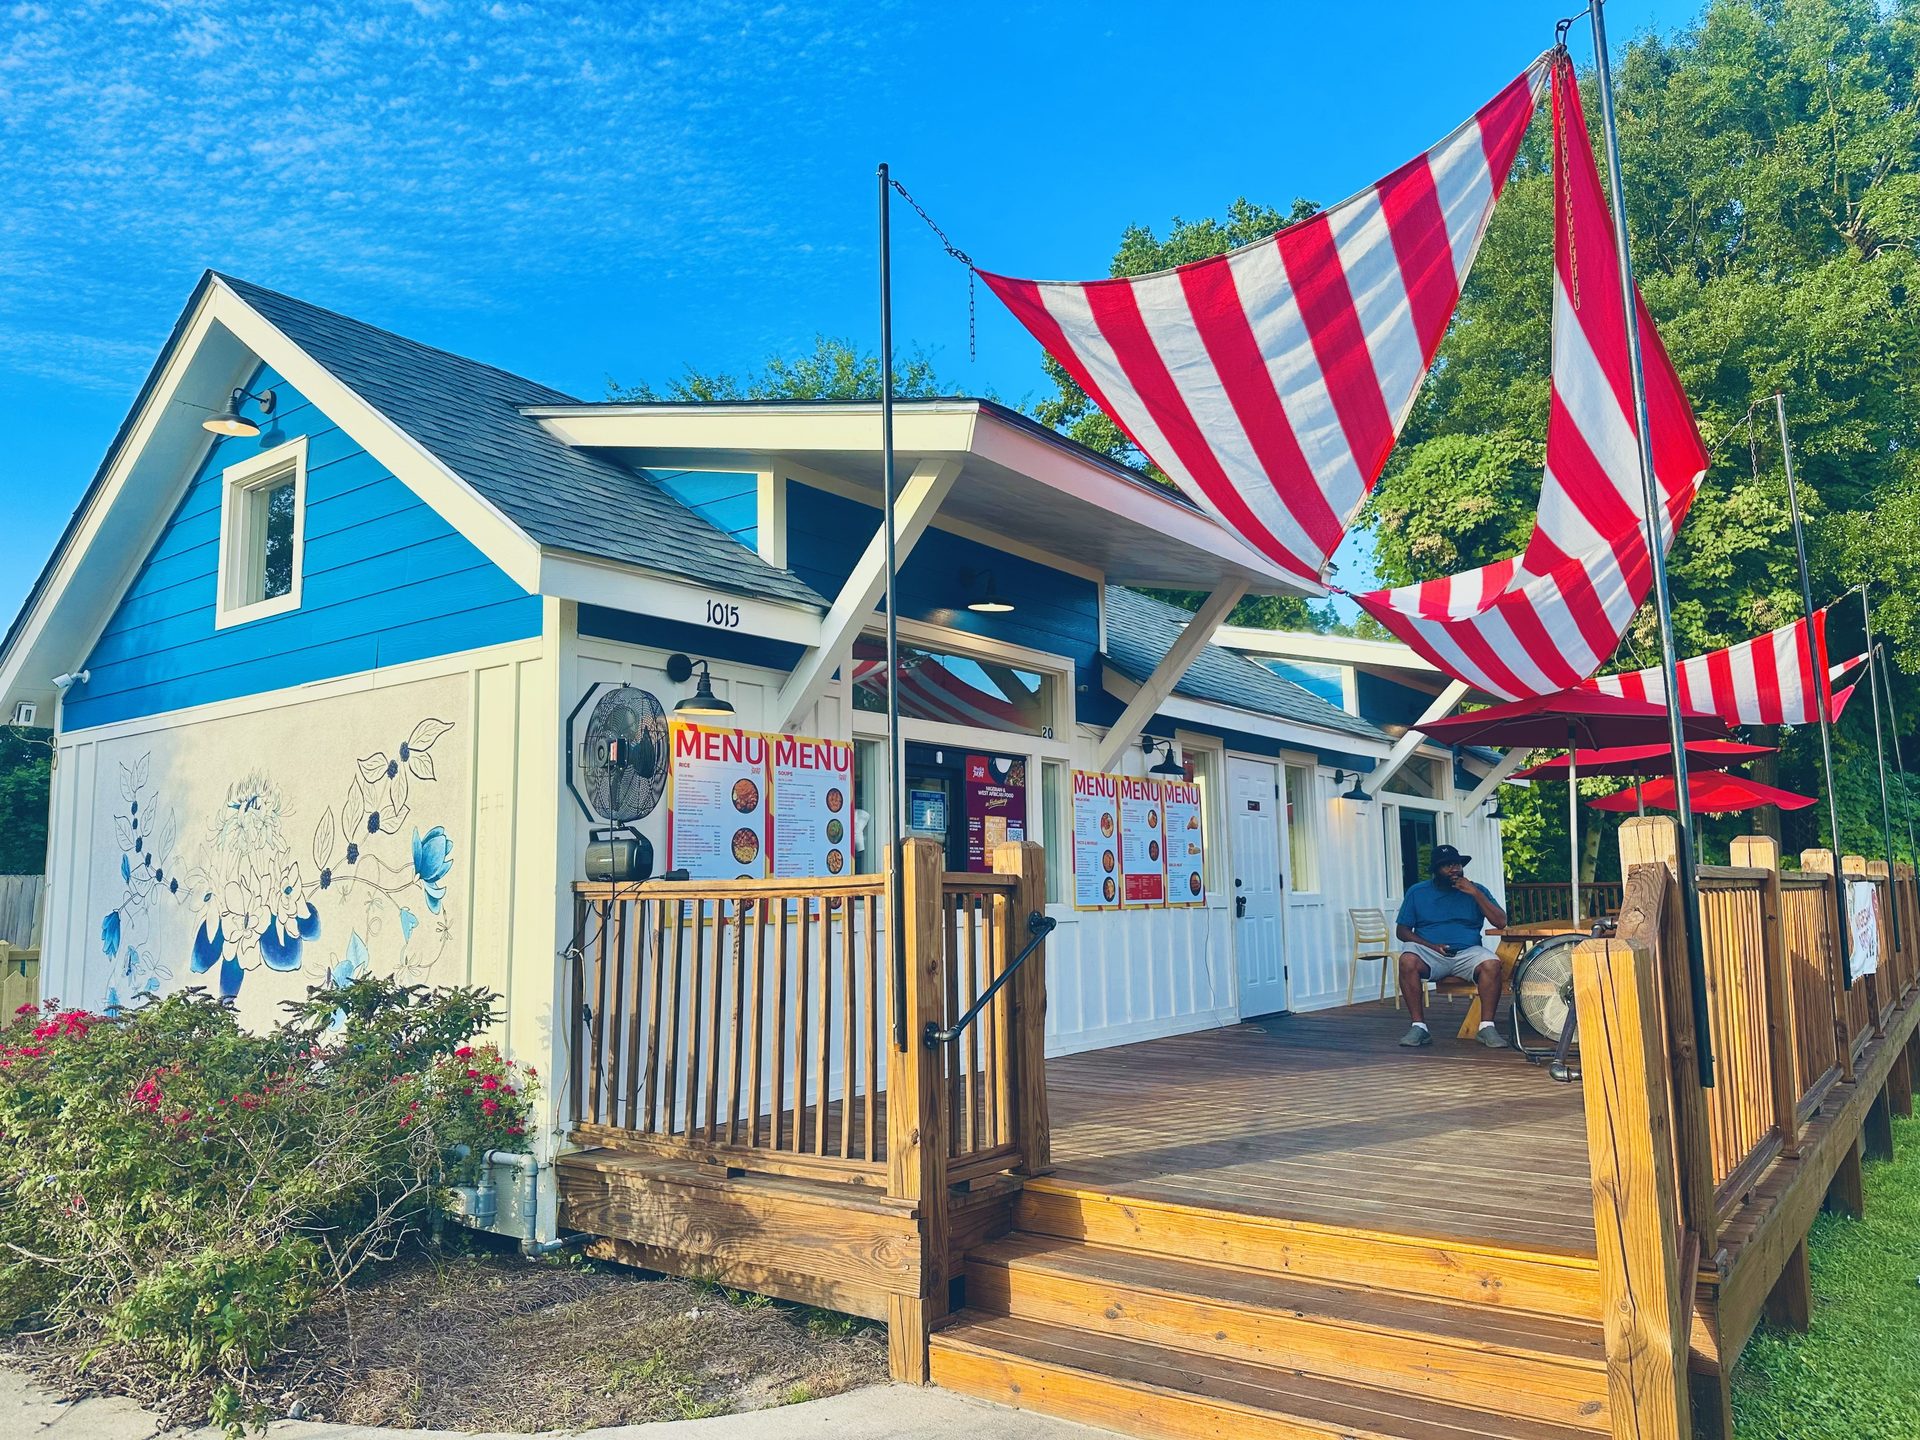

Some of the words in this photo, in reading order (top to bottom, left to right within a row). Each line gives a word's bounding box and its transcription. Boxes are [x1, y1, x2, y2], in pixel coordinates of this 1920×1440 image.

[707, 600, 739, 627] 1015
[1042, 726, 1053, 739] 20
[676, 729, 763, 765] MENU
[775, 740, 848, 772] MENU
[1074, 774, 1115, 798] MENU
[1121, 780, 1159, 801] MENU
[1164, 784, 1199, 805] MENU
